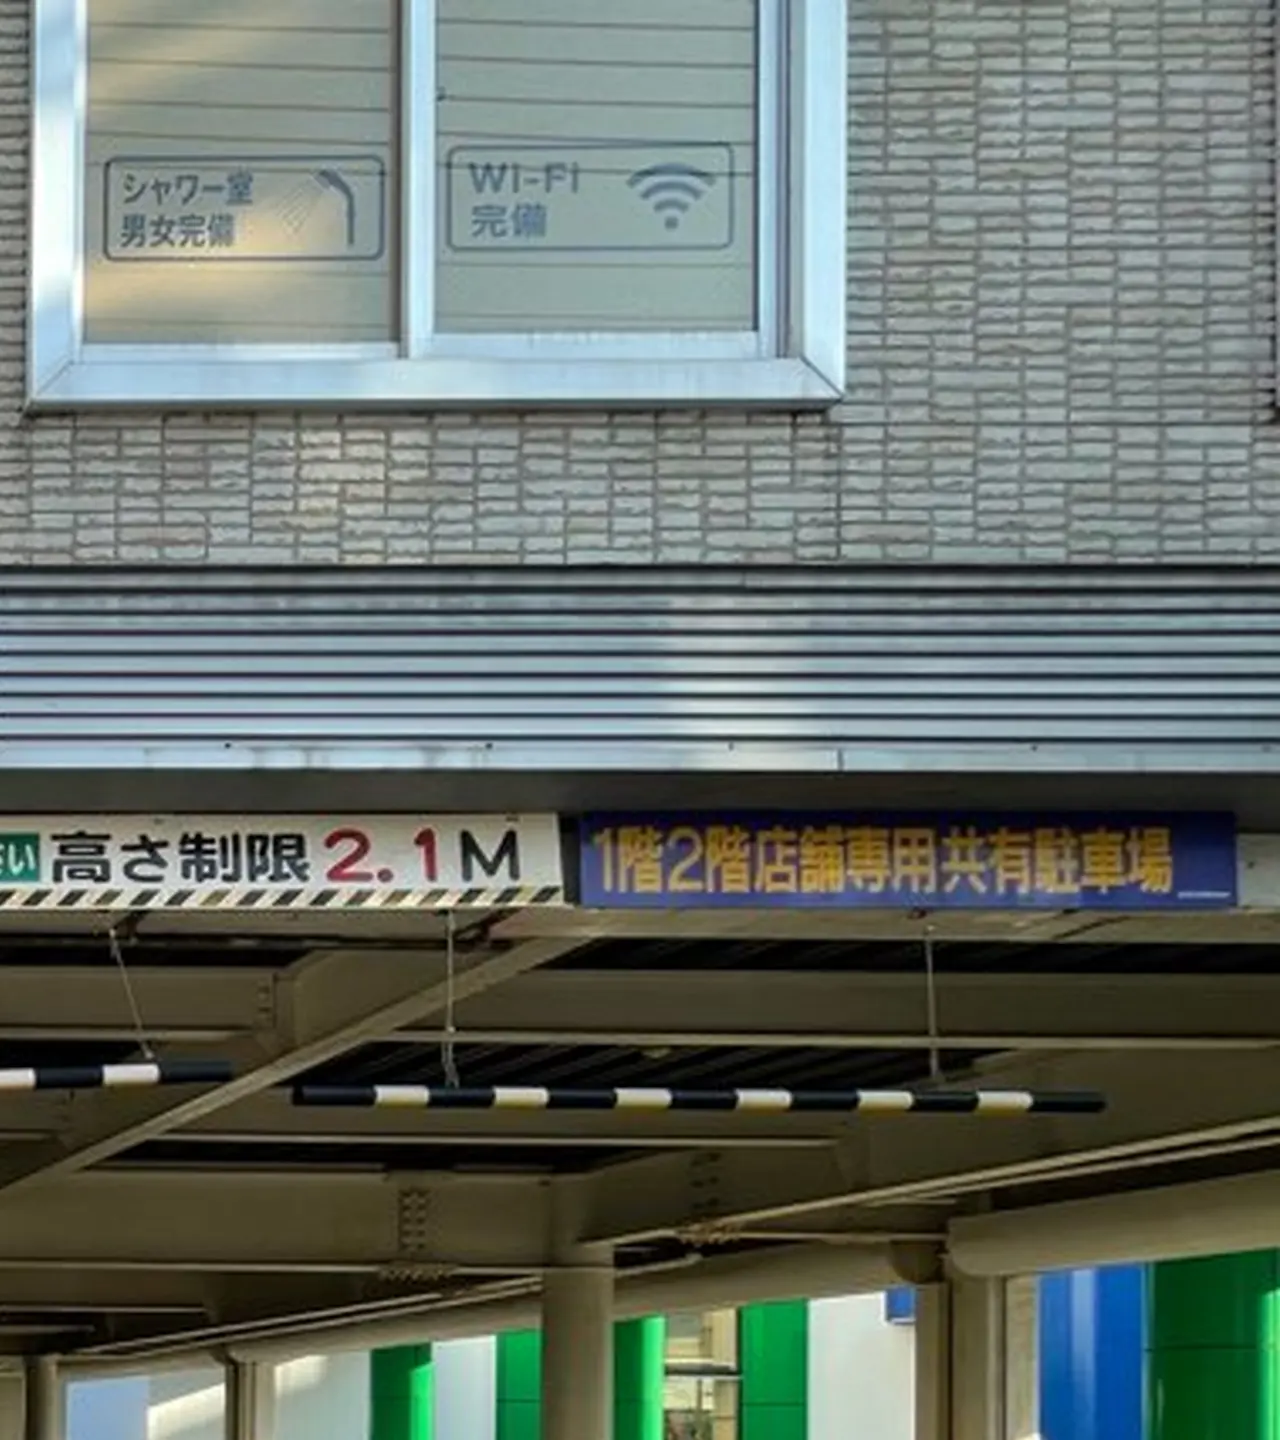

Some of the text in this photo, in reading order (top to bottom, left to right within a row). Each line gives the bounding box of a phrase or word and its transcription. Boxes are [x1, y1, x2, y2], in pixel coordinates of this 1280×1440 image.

[123, 170, 254, 207] シャワー室
[120, 212, 235, 248] 男女完備
[471, 202, 548, 238] 完備
